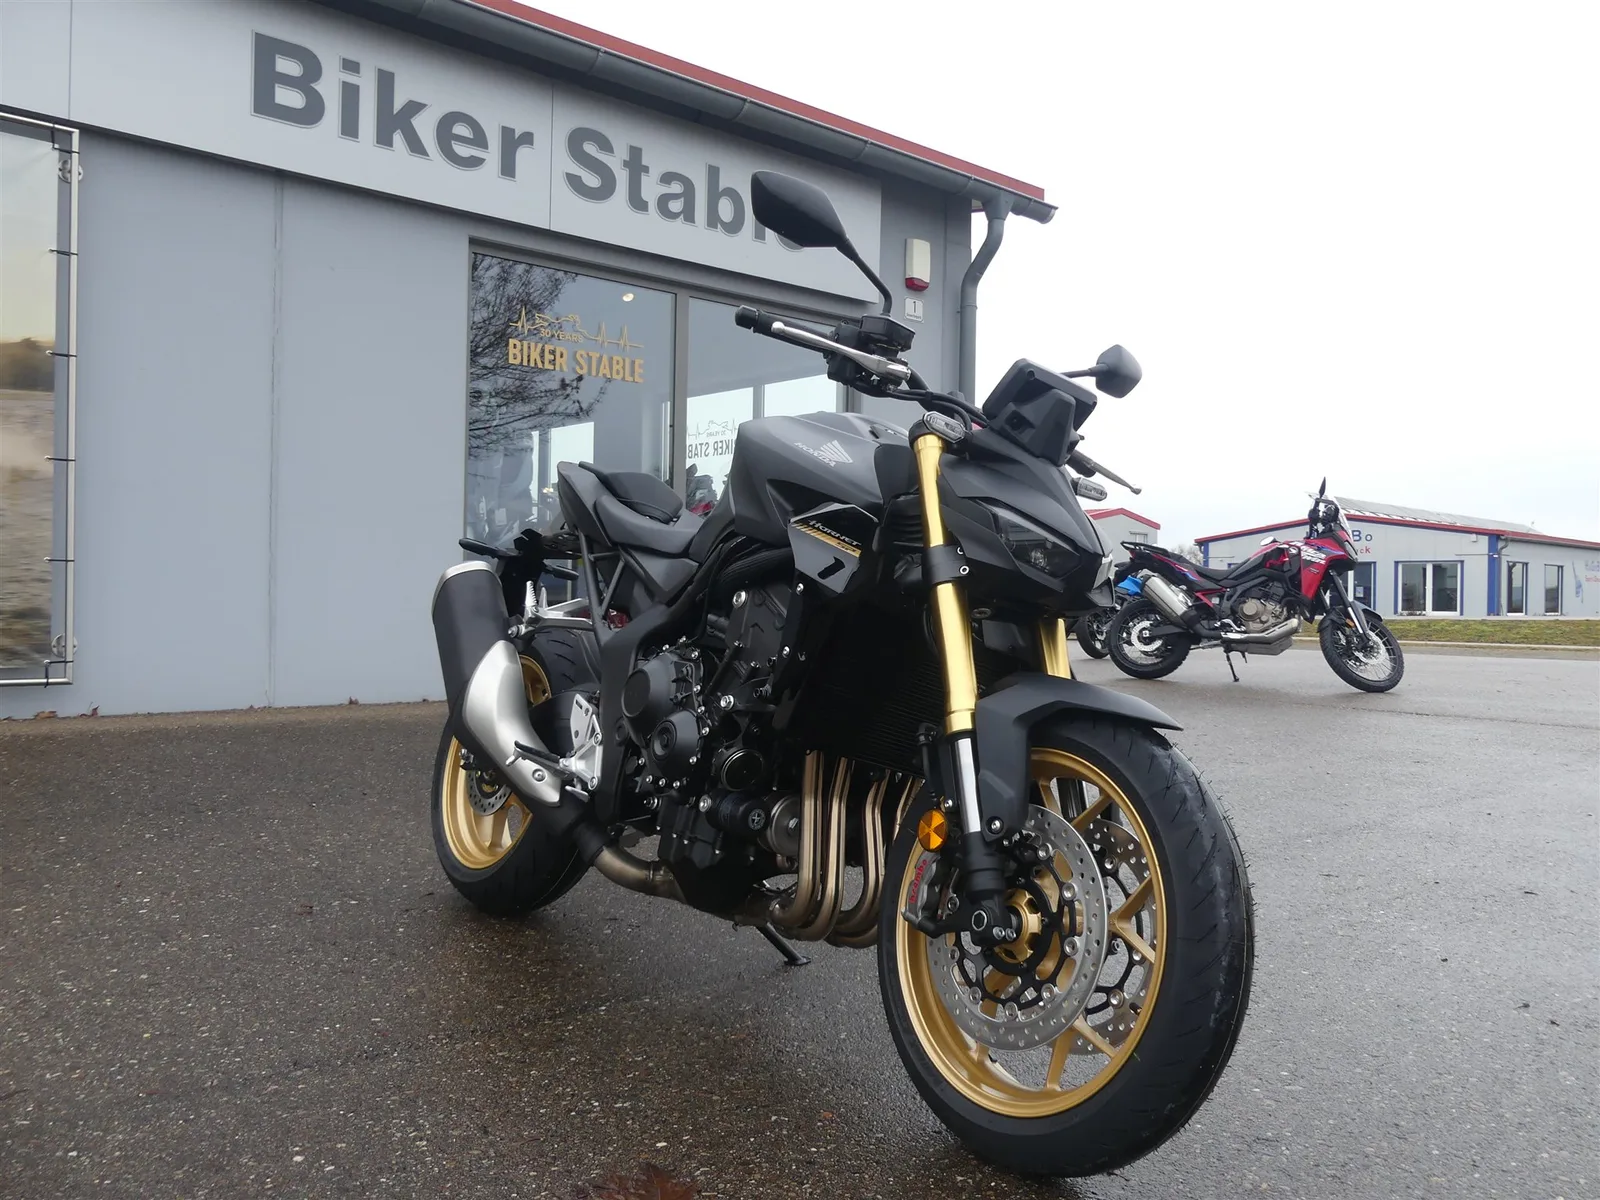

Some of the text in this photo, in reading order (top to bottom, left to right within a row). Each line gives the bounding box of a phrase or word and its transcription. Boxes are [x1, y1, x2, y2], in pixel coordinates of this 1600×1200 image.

[251, 30, 806, 252] Biker Stab
[913, 300, 917, 314] 1
[540, 329, 584, 343] 30 YEARS
[508, 338, 644, 383] BIKER STABLE
[909, 859, 927, 904] brembo
